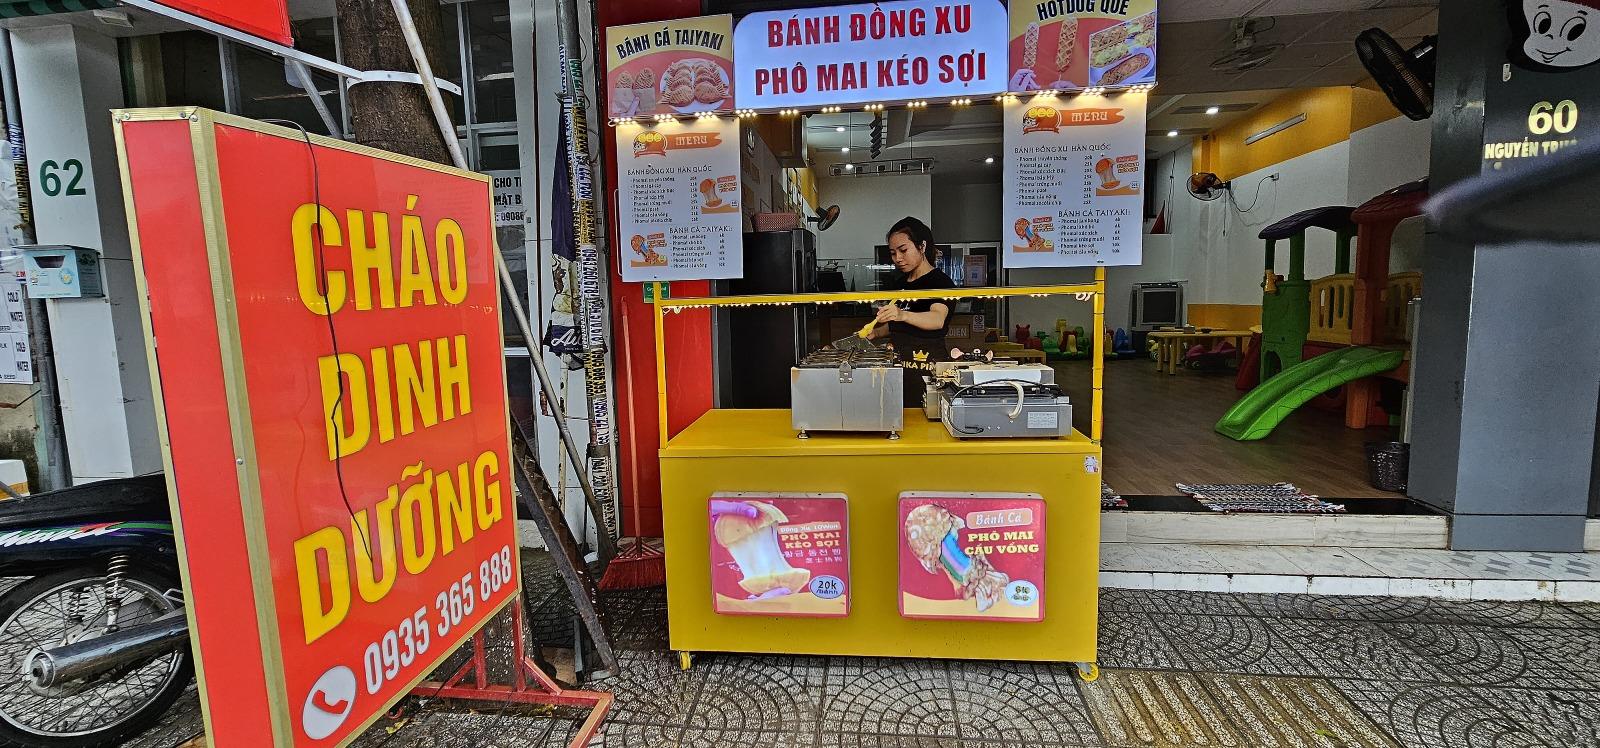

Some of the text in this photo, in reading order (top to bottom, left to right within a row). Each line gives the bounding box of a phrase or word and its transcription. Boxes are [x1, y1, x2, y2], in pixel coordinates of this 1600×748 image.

[768, 1, 971, 48] BÁNH ĐỒNG XU
[616, 27, 724, 59] BÁNH CÁ TAIYAKI
[755, 49, 986, 96] PHÔ MAI KÉO SỢI
[1071, 112, 1108, 122] MENU
[1528, 99, 1578, 134] 60
[675, 135, 707, 146] MENU
[1014, 146, 1034, 154] BÁNH
[39, 158, 87, 197] 62
[494, 177, 511, 188] CHO
[494, 193, 512, 207] MẶT
[1058, 209, 1080, 218] BÁNH
[669, 226, 689, 234] BÁNH
[291, 193, 469, 316] CHÁO
[902, 361, 918, 370] IKA
[317, 334, 473, 461] DINH
[976, 513, 1004, 525] Bánh
[781, 531, 840, 541] PHÔ MAI
[967, 530, 1034, 542] PHÔ MAI
[293, 450, 503, 645] DƯỠNG
[784, 540, 840, 549] KÉO SỢI
[818, 579, 837, 591] 20k
[363, 544, 512, 695] 0935 365 888
